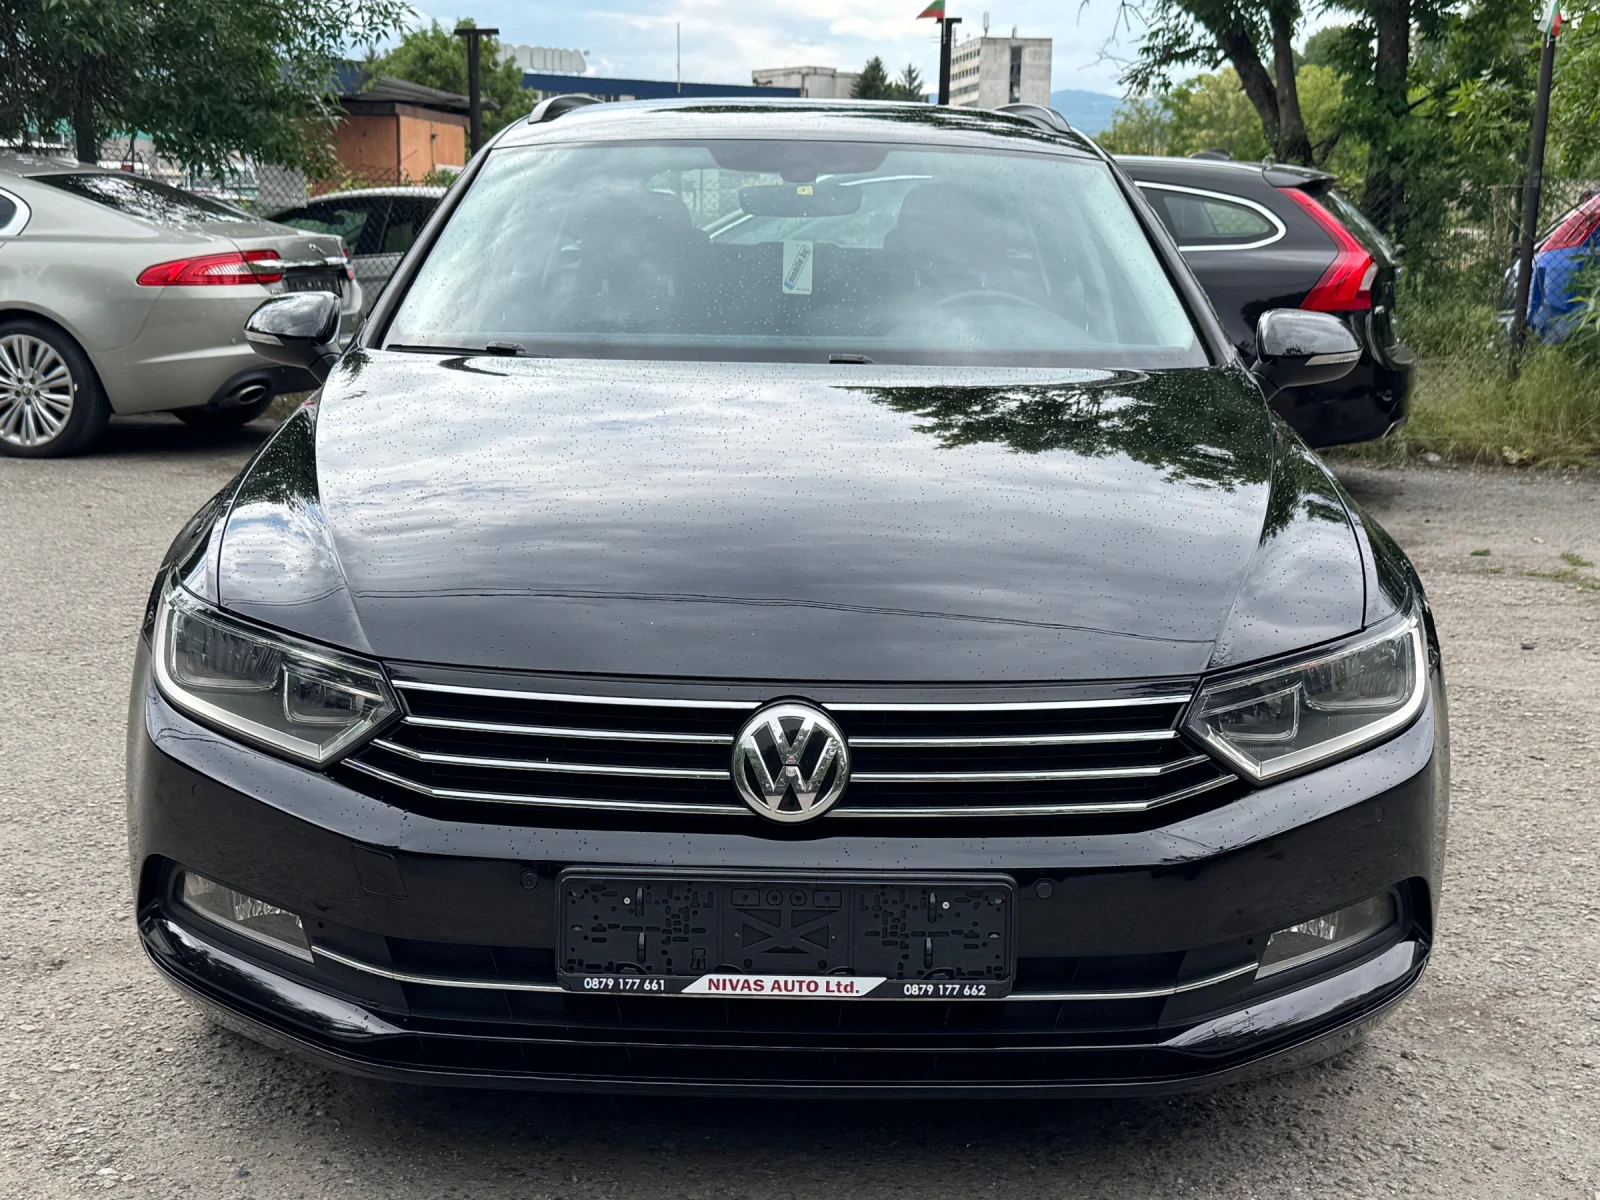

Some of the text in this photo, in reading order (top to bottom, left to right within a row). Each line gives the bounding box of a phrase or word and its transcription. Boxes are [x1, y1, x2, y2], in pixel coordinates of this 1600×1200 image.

[736, 706, 846, 820] VW
[583, 977, 665, 991] 0879 177 661
[708, 978, 860, 994] NIVAS AUTO Ltd.
[903, 983, 986, 997] 0879 177 662
